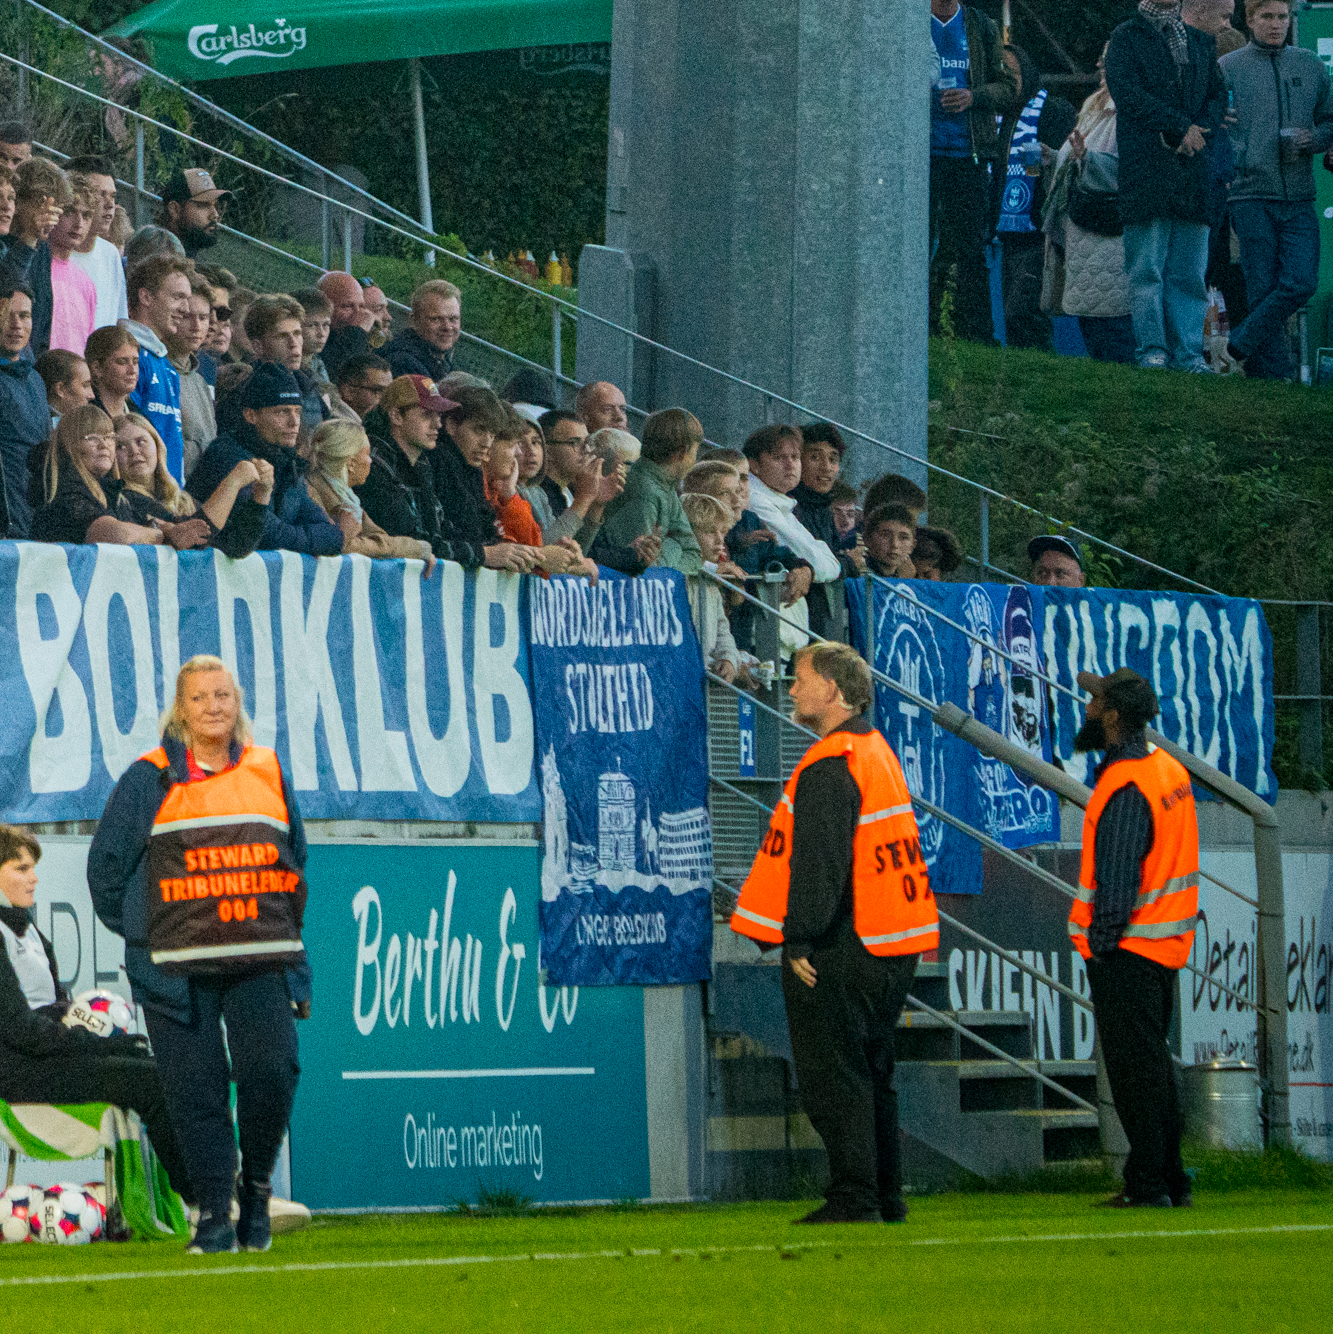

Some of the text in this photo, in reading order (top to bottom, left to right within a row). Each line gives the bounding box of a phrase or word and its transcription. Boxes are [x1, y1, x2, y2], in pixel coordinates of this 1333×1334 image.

[188, 19, 307, 65] Carlsberg
[185, 843, 280, 872] STEWARD
[218, 899, 259, 923] 004
[352, 869, 483, 1036] Berthu
[496, 887, 526, 1032] &
[71, 1006, 108, 1033] SELECT
[404, 1110, 544, 1181] Online marketing
